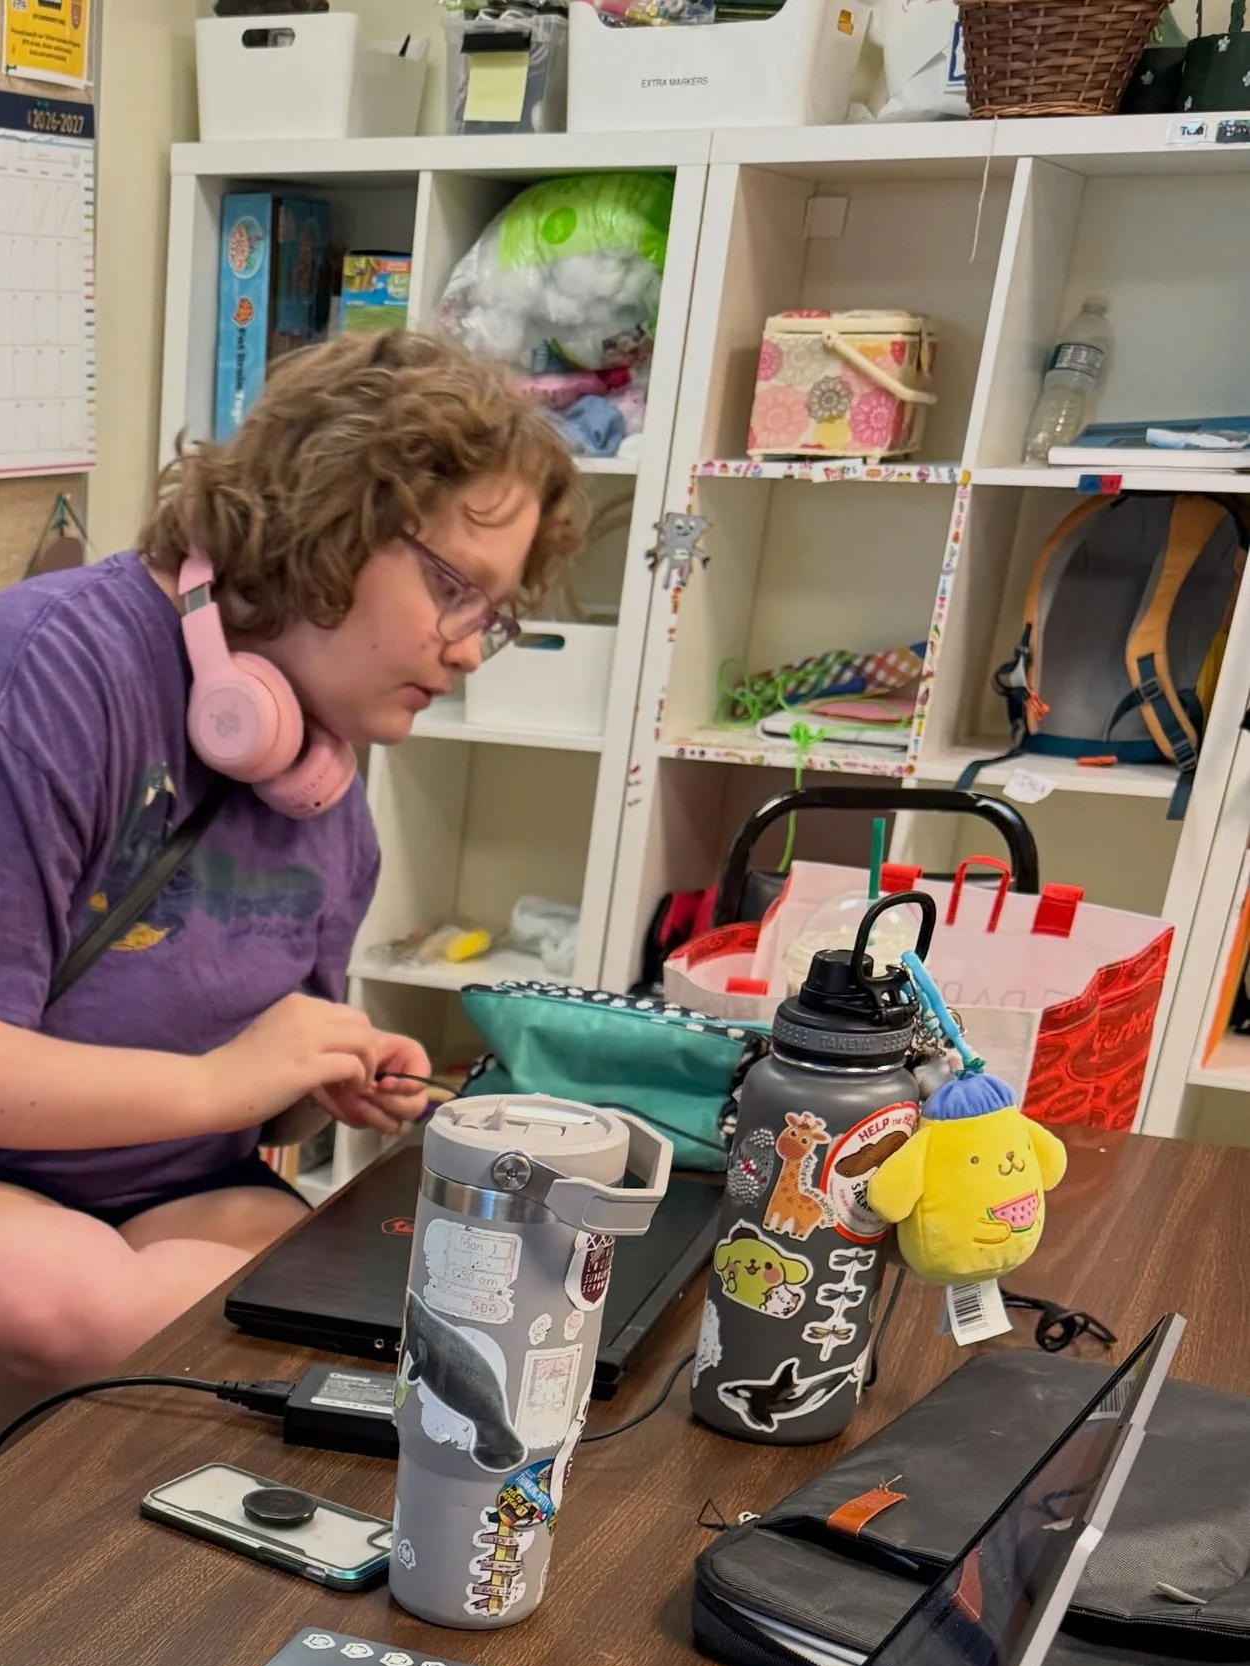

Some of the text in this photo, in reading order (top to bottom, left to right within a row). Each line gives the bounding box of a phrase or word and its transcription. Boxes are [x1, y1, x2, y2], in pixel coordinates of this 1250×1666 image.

[641, 77, 708, 88] EXTRA MARKERS
[820, 1035, 872, 1051] TAKEYA
[858, 1117, 890, 1143] HELP
